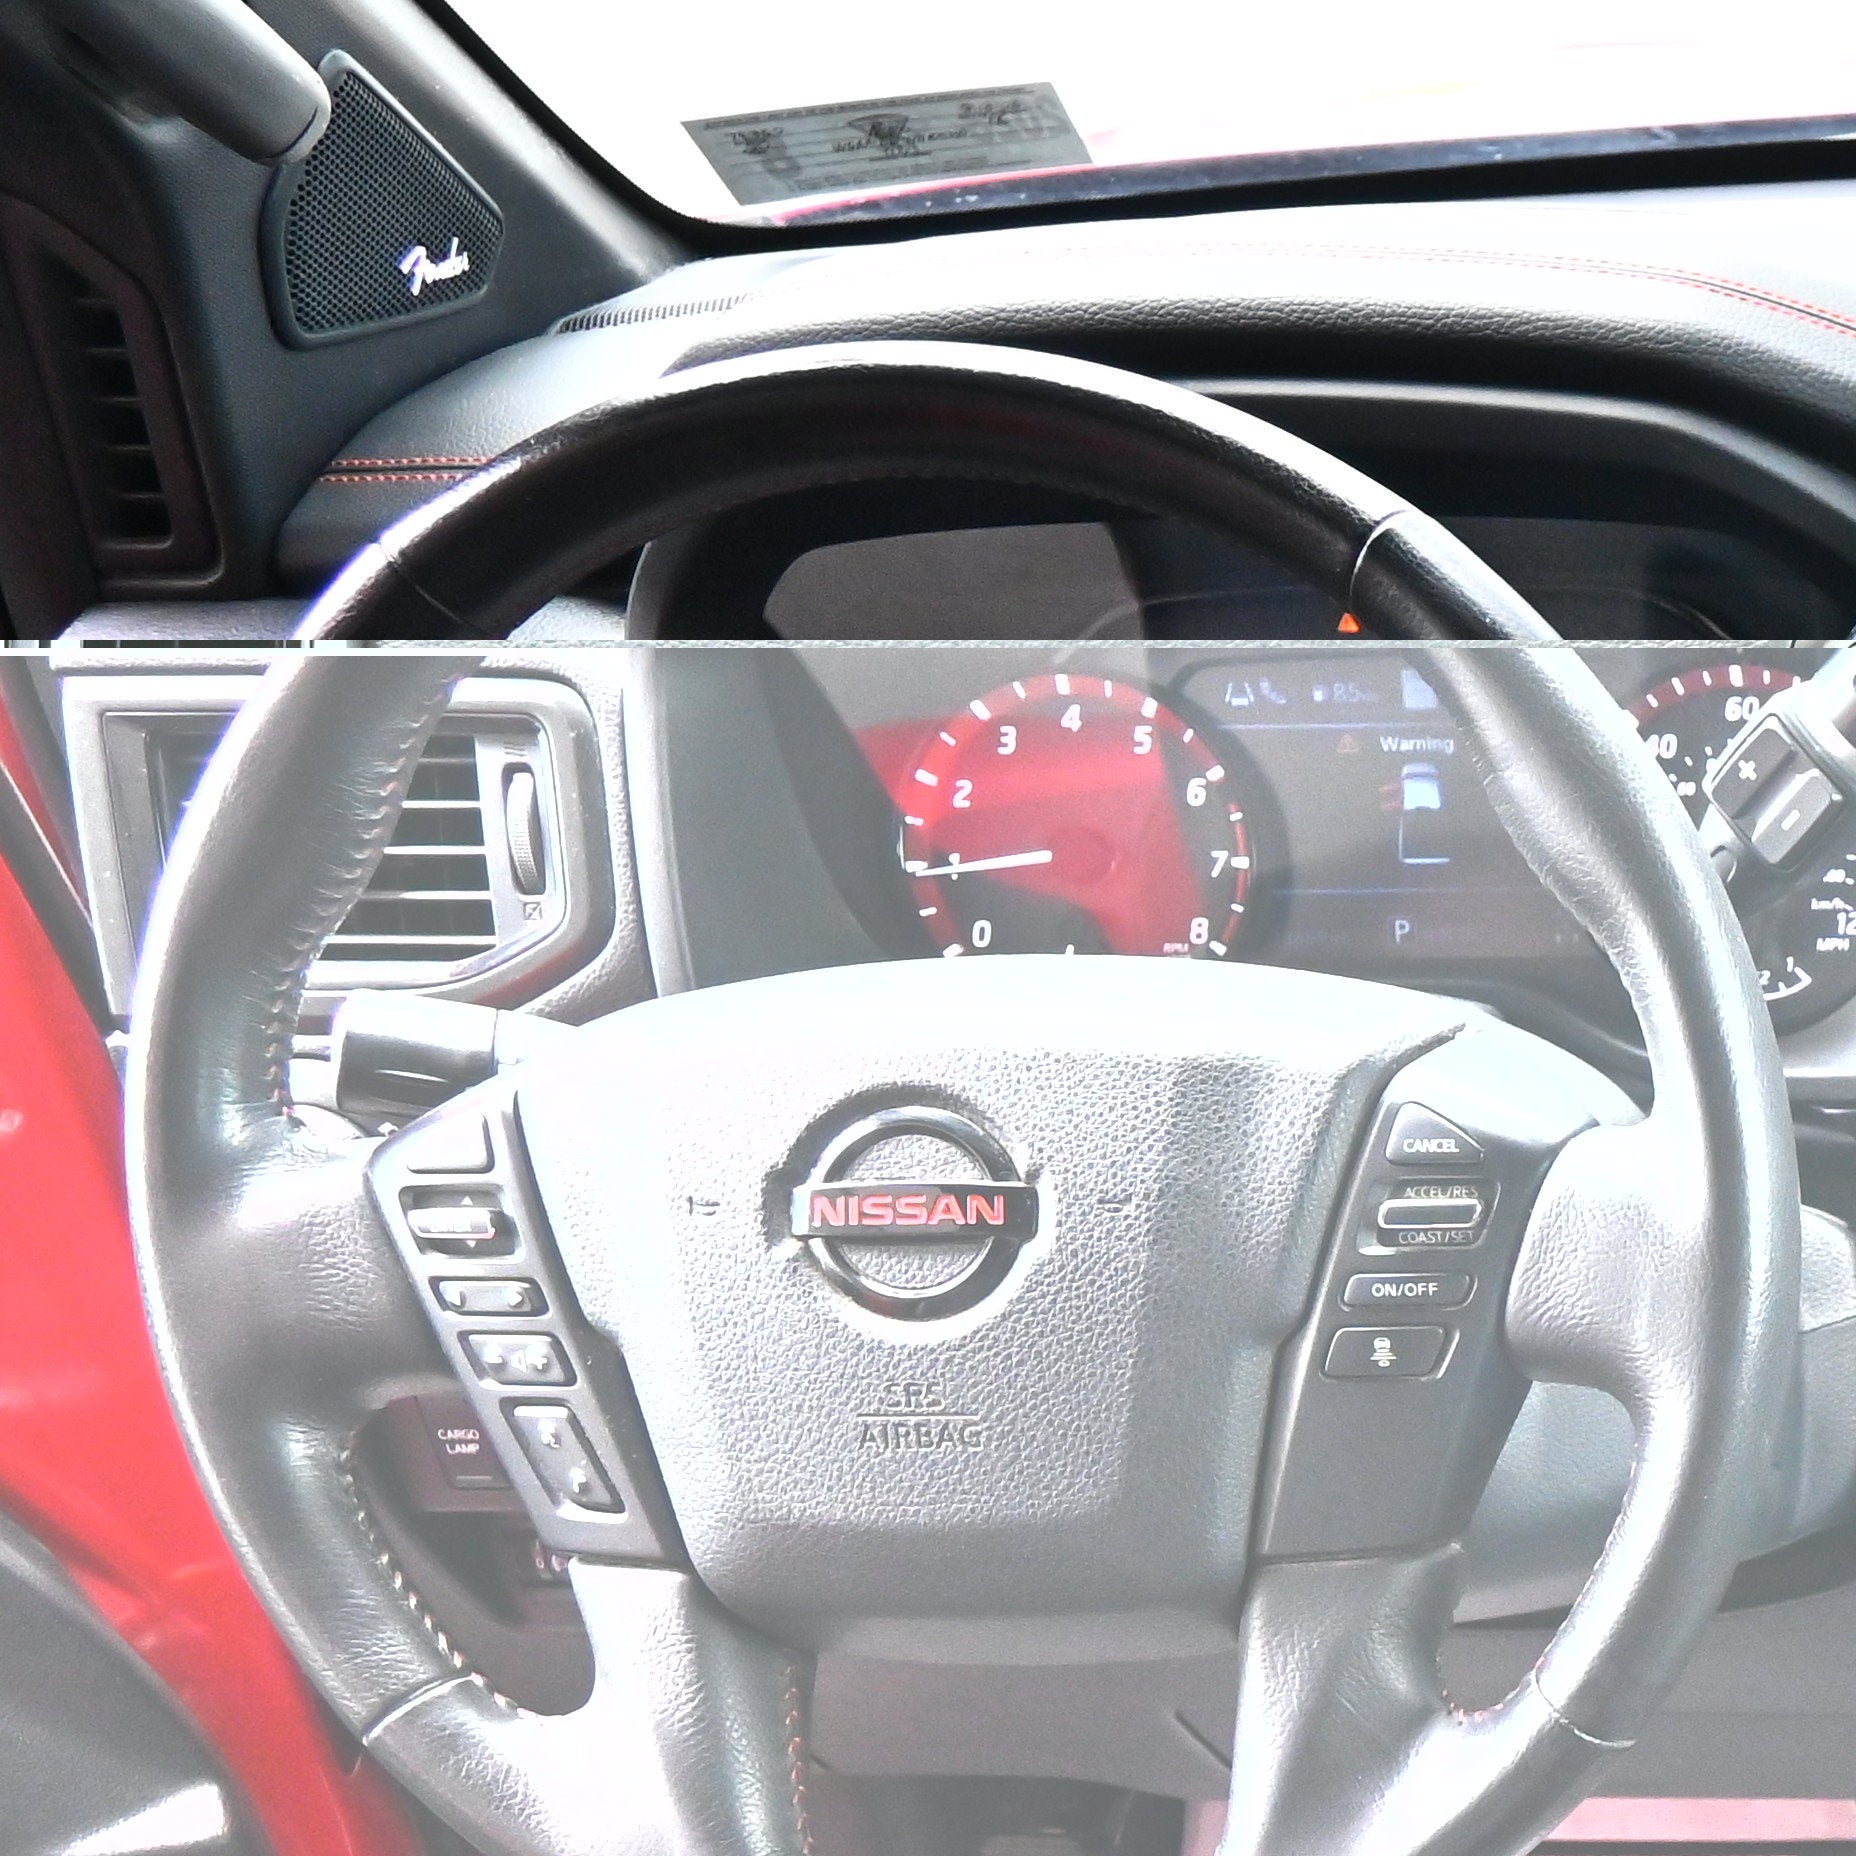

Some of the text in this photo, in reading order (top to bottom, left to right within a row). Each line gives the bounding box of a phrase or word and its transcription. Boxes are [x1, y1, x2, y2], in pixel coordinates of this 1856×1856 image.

[1060, 704, 1082, 732] 4
[1724, 696, 1760, 722] 60
[997, 725, 1018, 755] 3
[1133, 725, 1153, 755] 5
[1379, 736, 1455, 754] Warning
[952, 779, 973, 809] 2
[1186, 777, 1207, 807] 6
[1210, 850, 1230, 878] 7
[971, 919, 993, 948] 0
[1189, 917, 1209, 945] 8
[1394, 919, 1411, 943] P
[1403, 1138, 1460, 1153] CANCEL
[1403, 1185, 1479, 1199] ACCEL/RES
[808, 1193, 1006, 1228] NISSAN
[1398, 1231, 1476, 1245] COAST/SET
[1371, 1282, 1439, 1298] ON/OFF
[437, 1428, 480, 1442] CARGO
[445, 1442, 480, 1456] LAMP
[856, 1421, 984, 1453] AIRBAG
